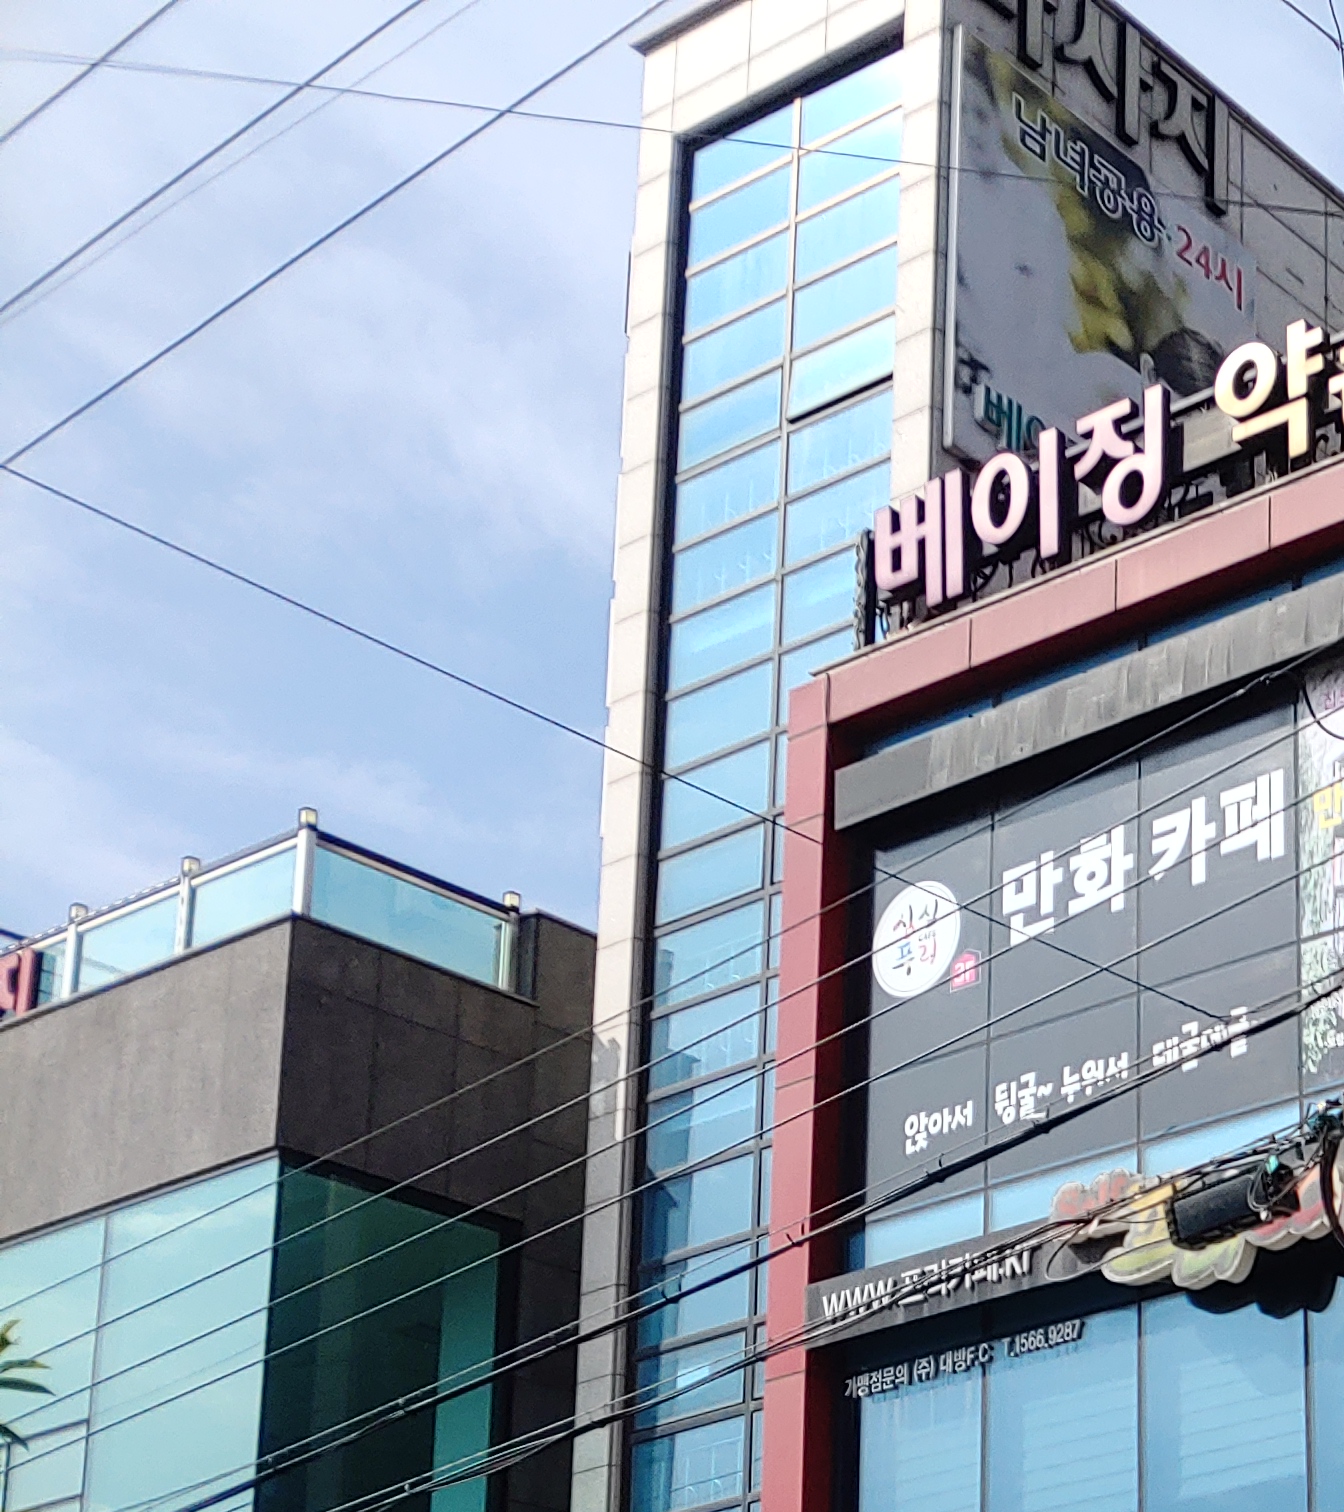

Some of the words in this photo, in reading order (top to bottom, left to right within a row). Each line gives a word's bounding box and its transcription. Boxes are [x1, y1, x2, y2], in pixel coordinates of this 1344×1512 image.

[1012, 92, 1167, 247] 남녀공용
[874, 384, 1171, 605] 베이징
[1002, 816, 1135, 948] 만화
[1149, 768, 1287, 886] 카페
[904, 1101, 974, 1155] 앉아서
[1060, 1052, 1129, 1106] 누워서
[844, 1363, 909, 1399] 가맹점문의
[913, 1355, 935, 1382] (주)
